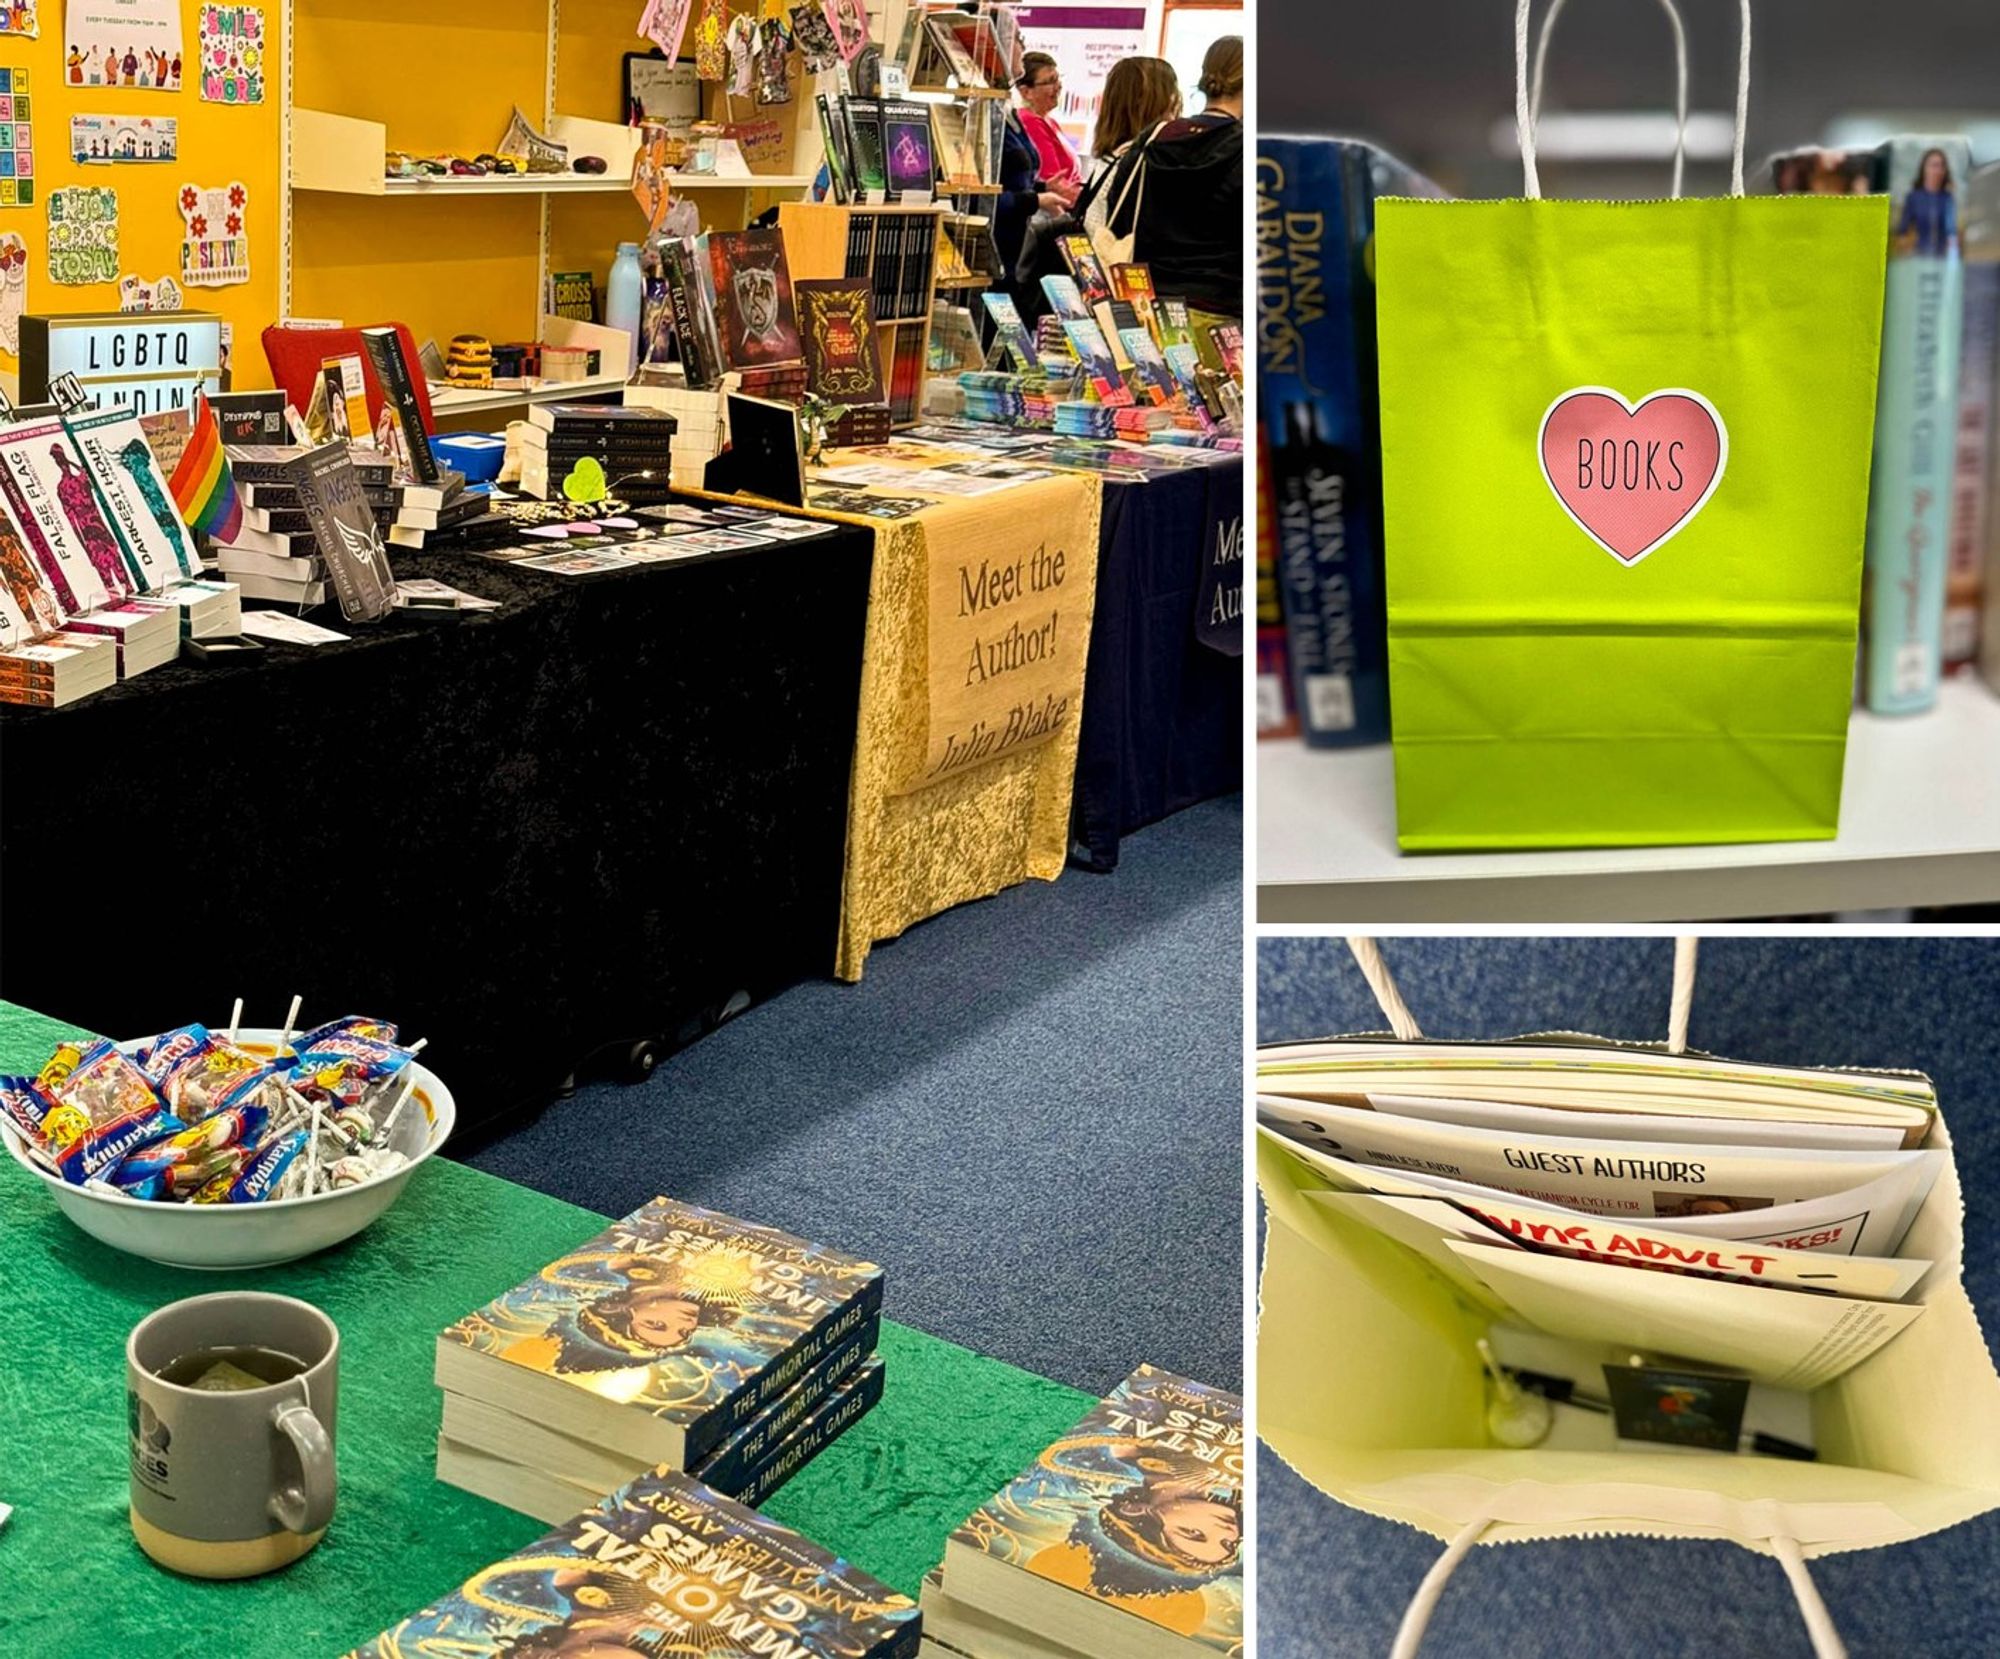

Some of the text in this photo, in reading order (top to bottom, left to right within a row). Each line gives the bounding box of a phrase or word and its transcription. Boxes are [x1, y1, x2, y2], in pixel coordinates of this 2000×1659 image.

[206, 10, 256, 39] SMILE
[204, 75, 258, 102] MORE
[744, 132, 783, 148] Writing
[51, 190, 116, 222] ENJOY
[51, 250, 118, 278] TODAY
[182, 240, 247, 270] POSITIVE
[1256, 156, 1298, 374] GABALDON
[1284, 211, 1325, 329] DIANA
[556, 282, 592, 304] CROSS
[89, 331, 188, 370] LGBTQ
[51, 371, 86, 411] £10
[236, 421, 254, 437] UK
[10, 450, 40, 500] FLAG
[83, 438, 115, 487] HOUR
[241, 464, 288, 480] ANGELS
[1577, 437, 1685, 492] BOOKS
[293, 468, 325, 519] ANGELS
[1305, 467, 1345, 563] SEVEN
[35, 504, 72, 561] FALSE
[109, 489, 154, 567] DARKEST
[1281, 500, 1316, 593] STAND
[957, 541, 1066, 618] Meet the
[965, 609, 1058, 687] Author!
[926, 693, 1068, 781] Julia Blake
[243, 1138, 297, 1198] Starmix
[1427, 1157, 1461, 1177] AVERY
[1502, 1147, 1706, 1185] GUEST AUTHORS
[1580, 1196, 1614, 1209] CYCLE
[1617, 1200, 1641, 1211] FOR
[1606, 1233, 1779, 1276] ADULT
[733, 1303, 863, 1421] THE IMMORTAL GAMES
[742, 1341, 861, 1464] THE IMMORTAL GAMES
[759, 1428, 822, 1492] IMMORTAL
[825, 1392, 864, 1435] GAMES
[638, 1491, 874, 1623] ANNALIESE AVERY
[639, 1522, 807, 1623] GAMES
[642, 1601, 694, 1636] THE
